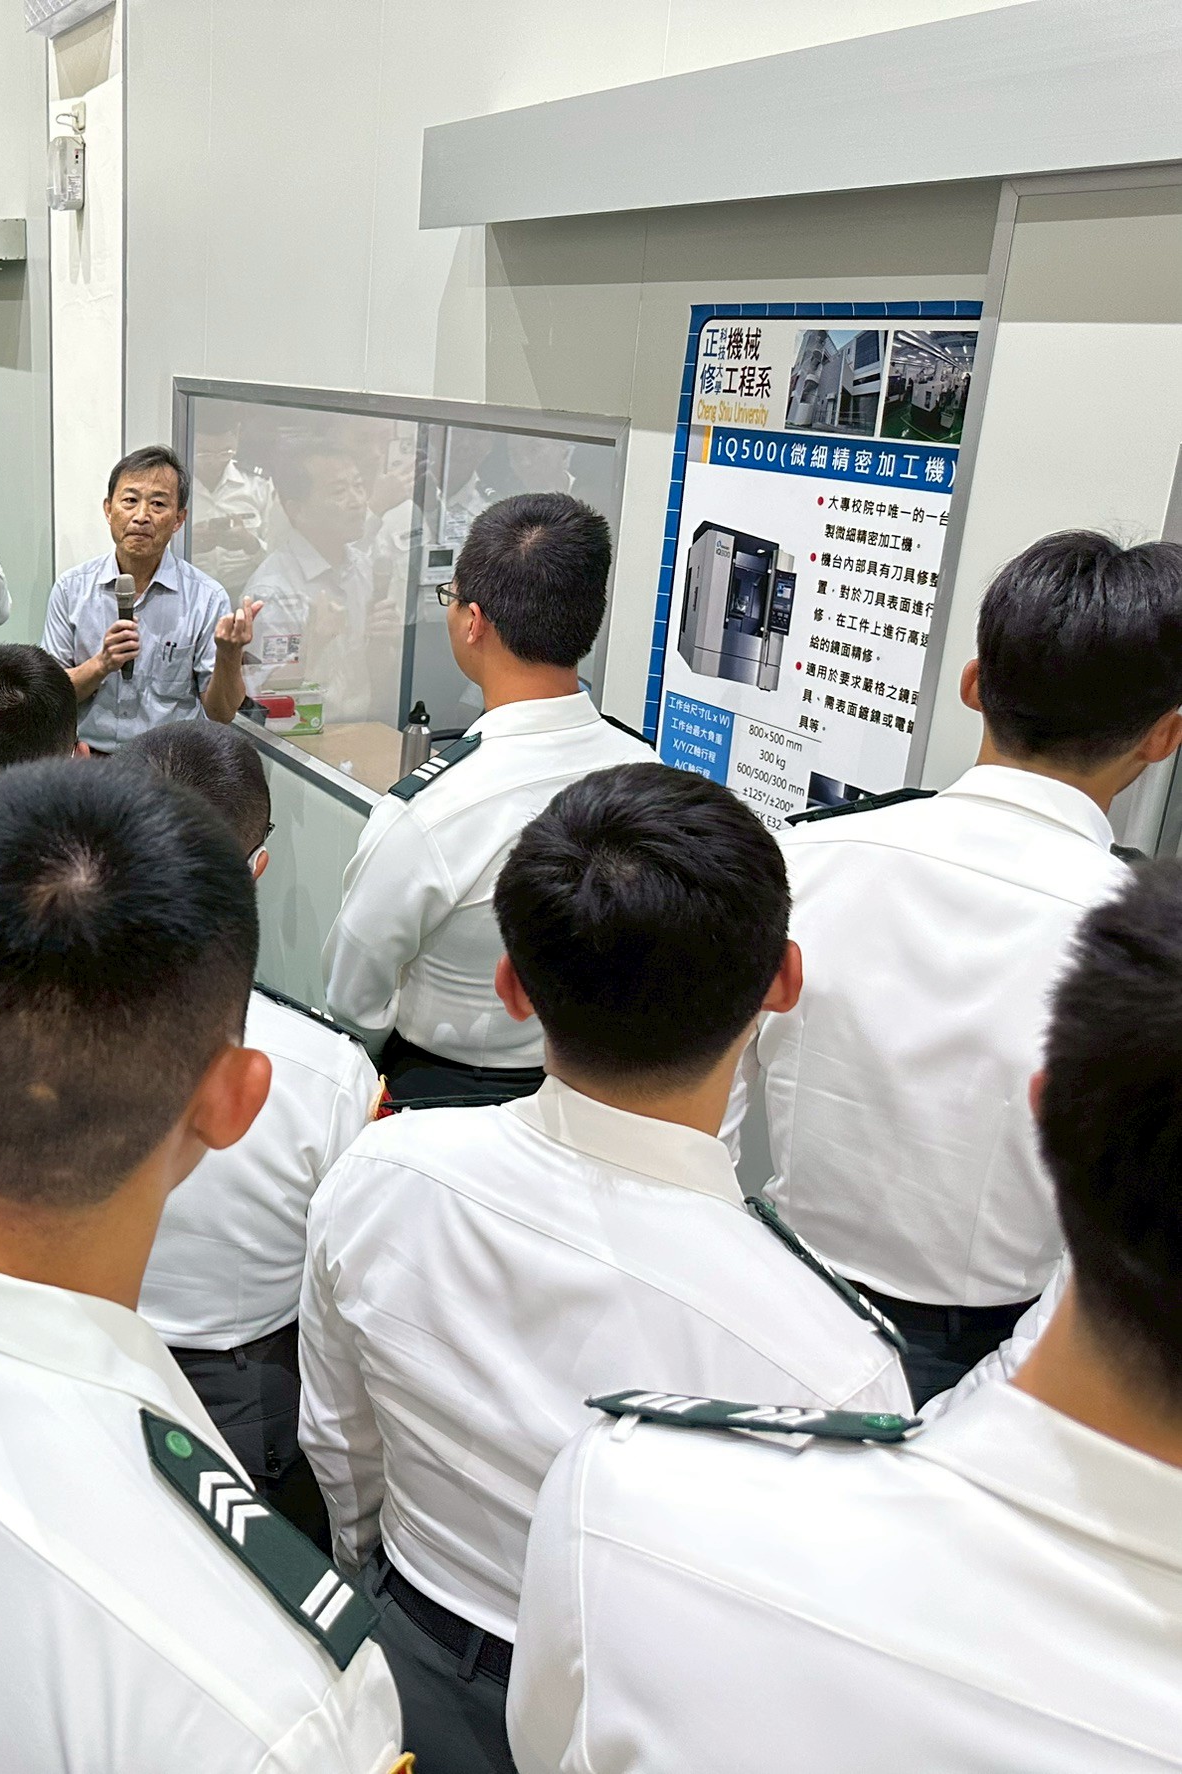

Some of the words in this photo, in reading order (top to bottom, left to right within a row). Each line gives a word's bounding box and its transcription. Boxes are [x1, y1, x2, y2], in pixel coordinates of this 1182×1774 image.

[697, 399, 716, 423] Cheng
[718, 401, 733, 422] Shiu
[734, 402, 769, 428] University
[717, 436, 956, 487] iQ500(微細精密加工機)
[785, 739, 803, 752] mm
[759, 749, 775, 764] 300
[775, 754, 786, 770] kg
[736, 762, 787, 790] 600/500/300
[788, 783, 805, 797] mm
[766, 815, 782, 830] E32
